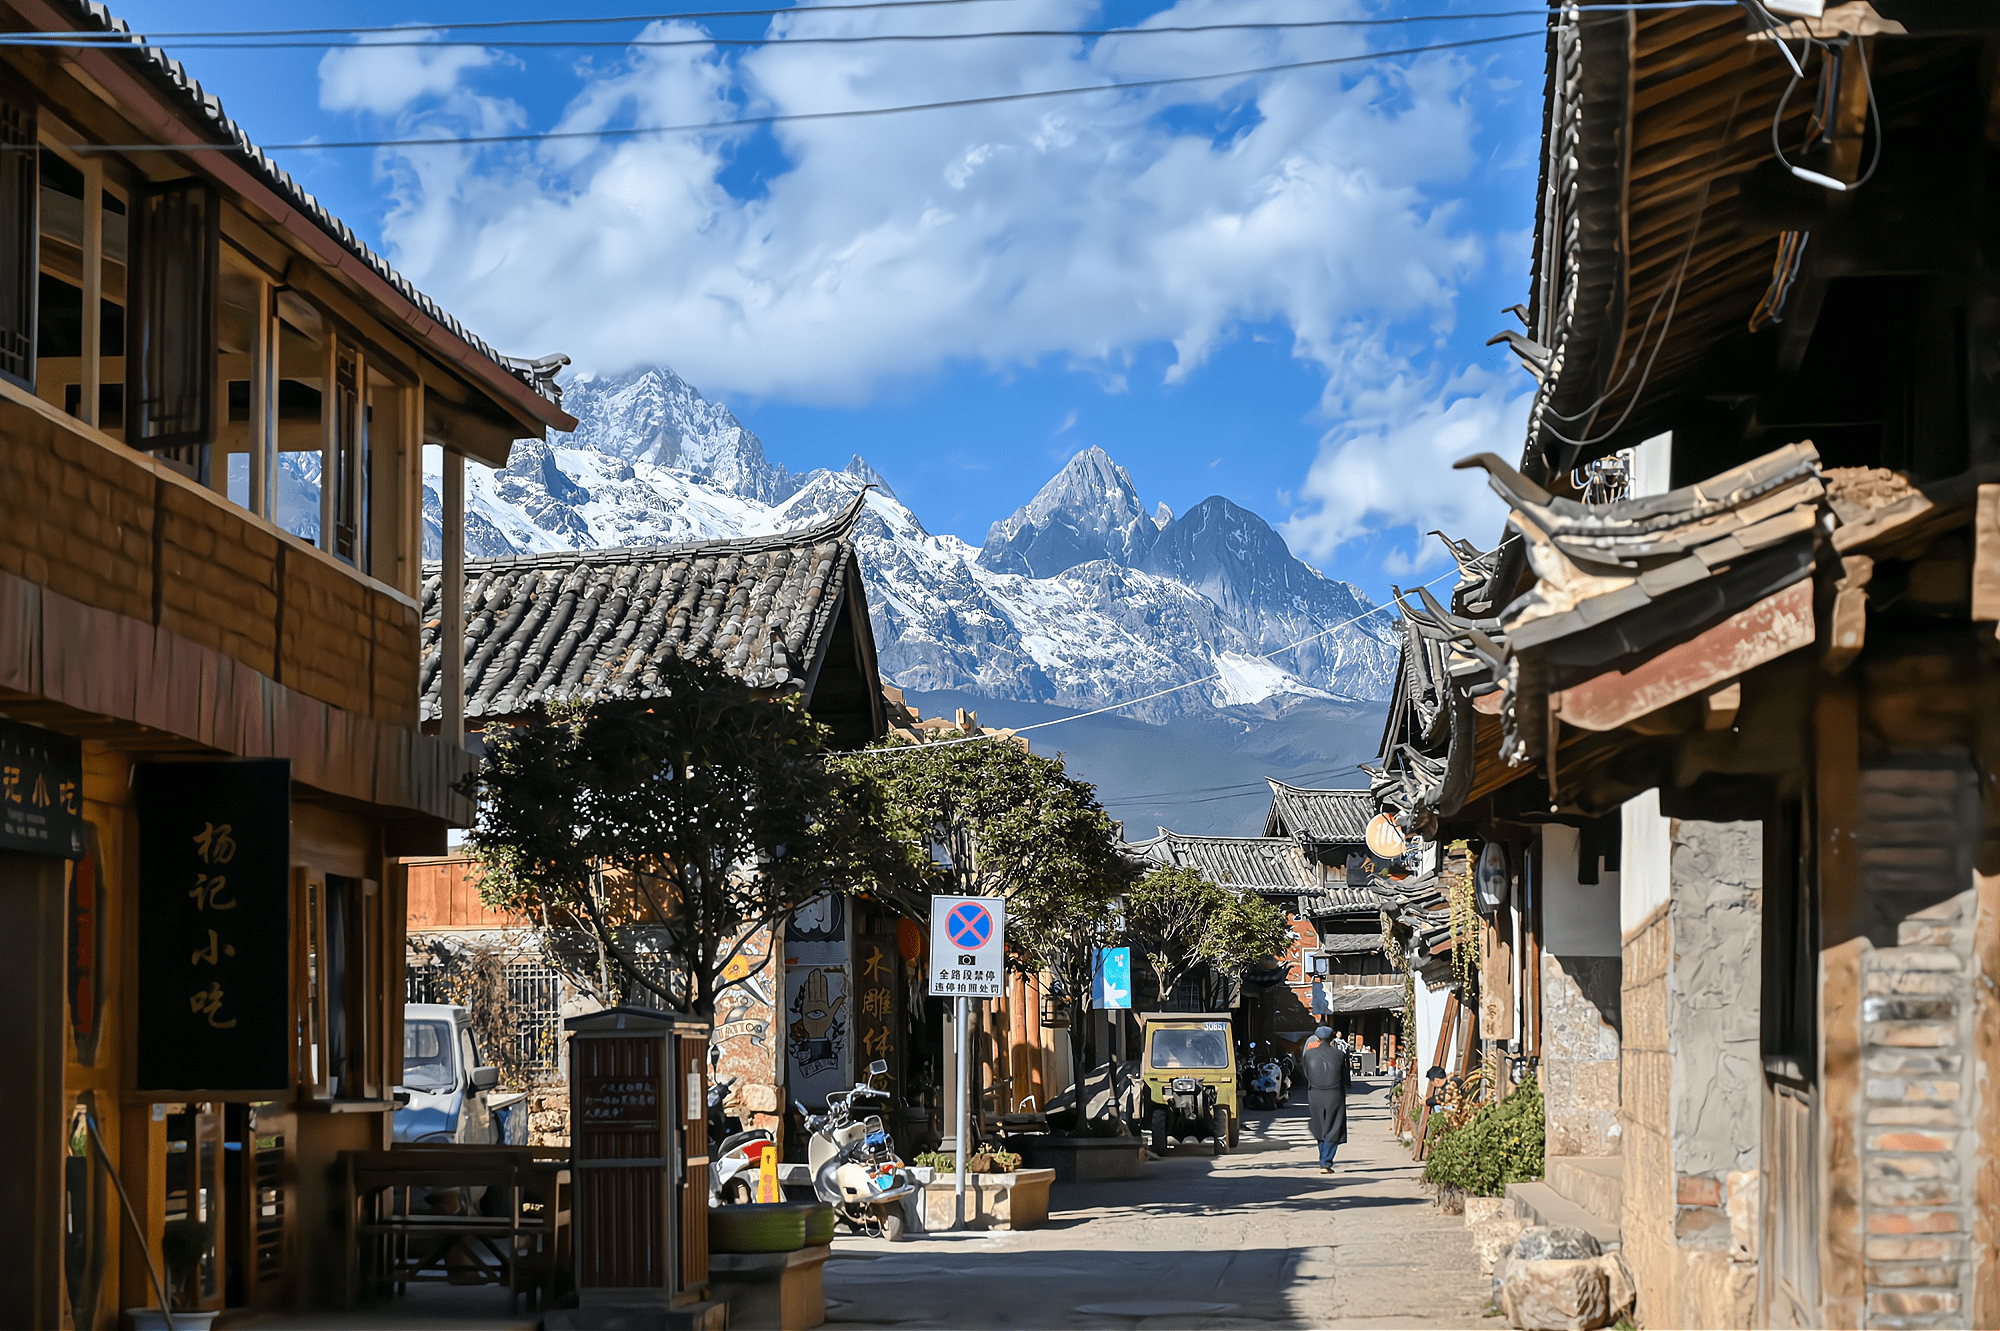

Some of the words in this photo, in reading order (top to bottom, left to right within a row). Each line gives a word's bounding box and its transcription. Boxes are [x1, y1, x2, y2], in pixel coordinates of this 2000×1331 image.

[189, 821, 237, 1028] 杨记小吃
[939, 969, 995, 981] 全路段禁停
[934, 982, 999, 993] 违停拍照处罚
